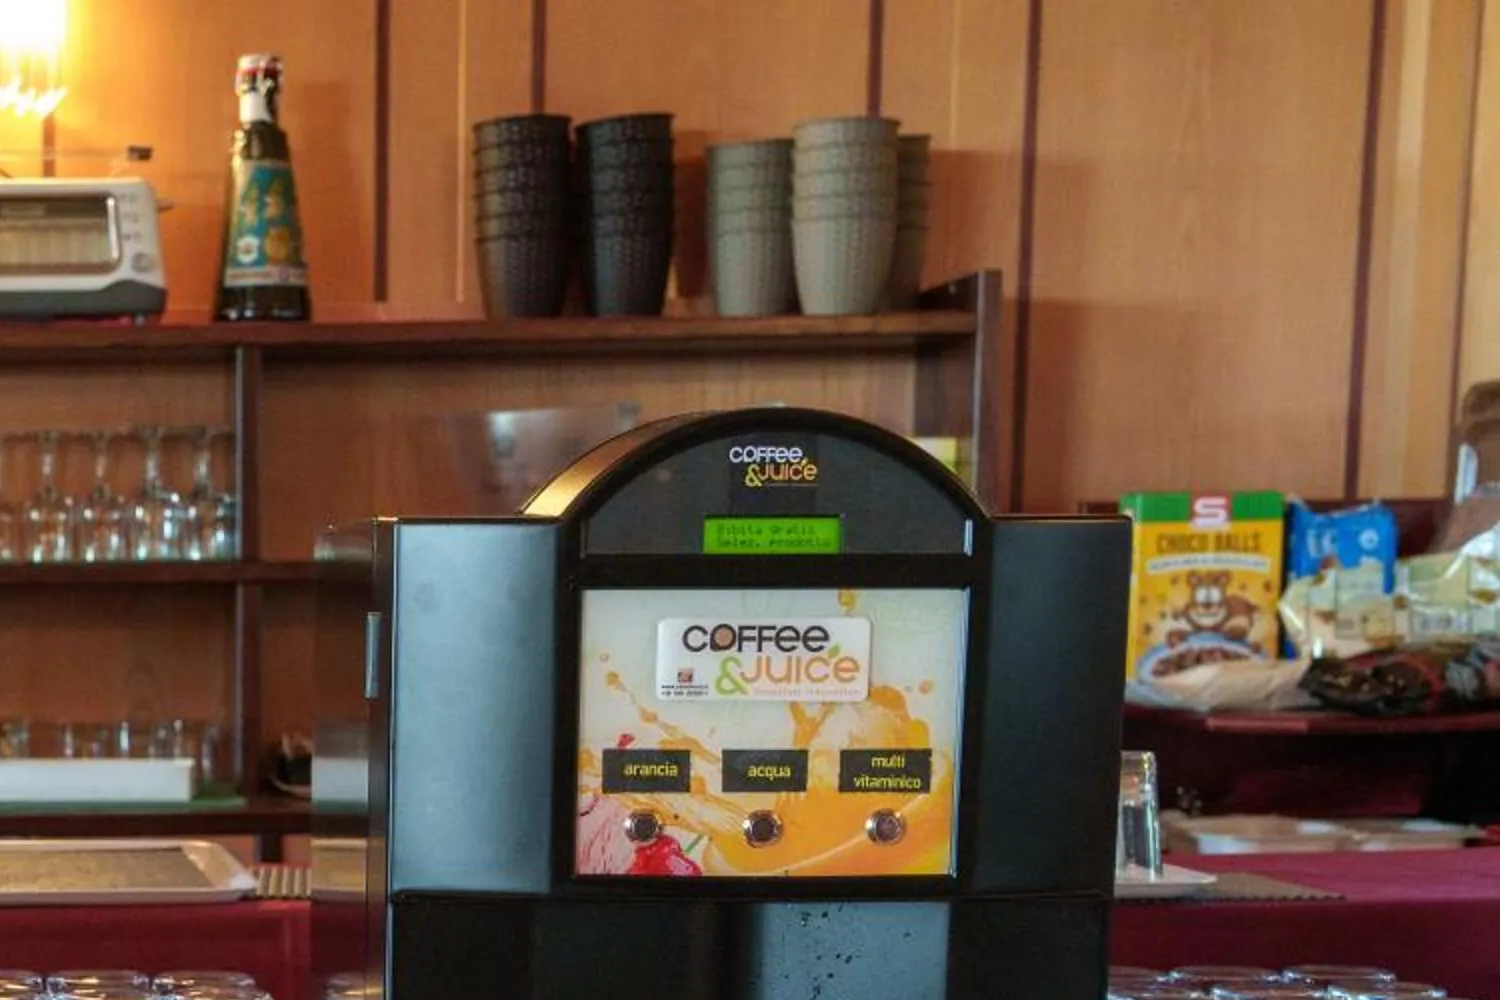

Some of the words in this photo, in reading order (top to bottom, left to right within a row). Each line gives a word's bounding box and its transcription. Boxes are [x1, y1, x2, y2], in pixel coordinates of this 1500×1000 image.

[623, 761, 679, 777] arancia
[871, 754, 906, 769] multi
[747, 763, 792, 781] acqua
[853, 773, 922, 790] vitaminico
